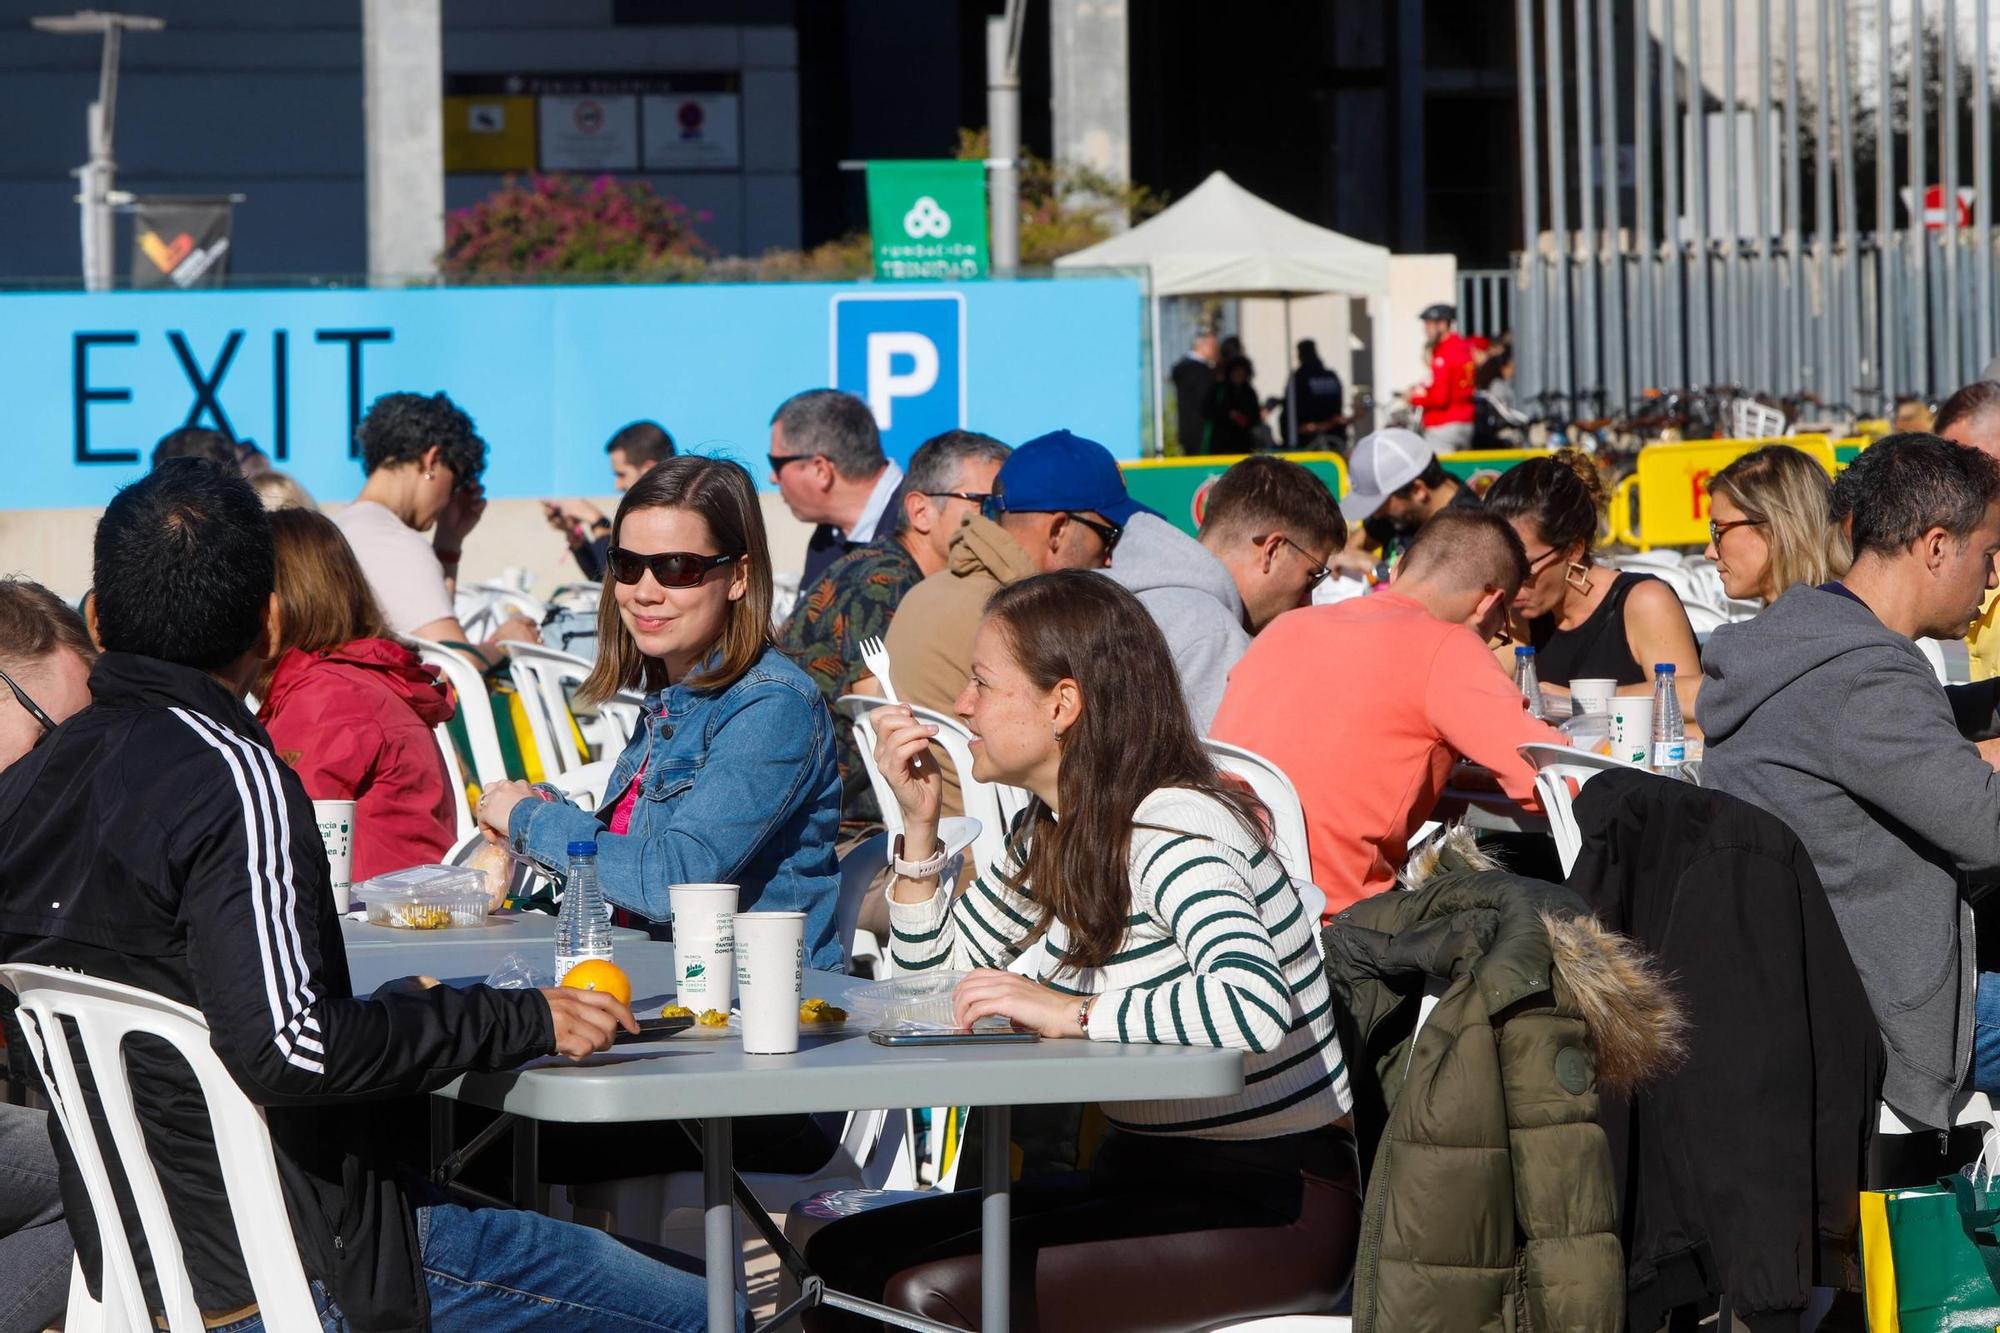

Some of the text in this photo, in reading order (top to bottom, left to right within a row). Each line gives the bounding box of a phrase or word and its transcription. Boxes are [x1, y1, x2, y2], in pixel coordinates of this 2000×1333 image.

[881, 260, 978, 280] TRINIDAD
[74, 328, 394, 465] EXIT
[867, 331, 939, 430] P
